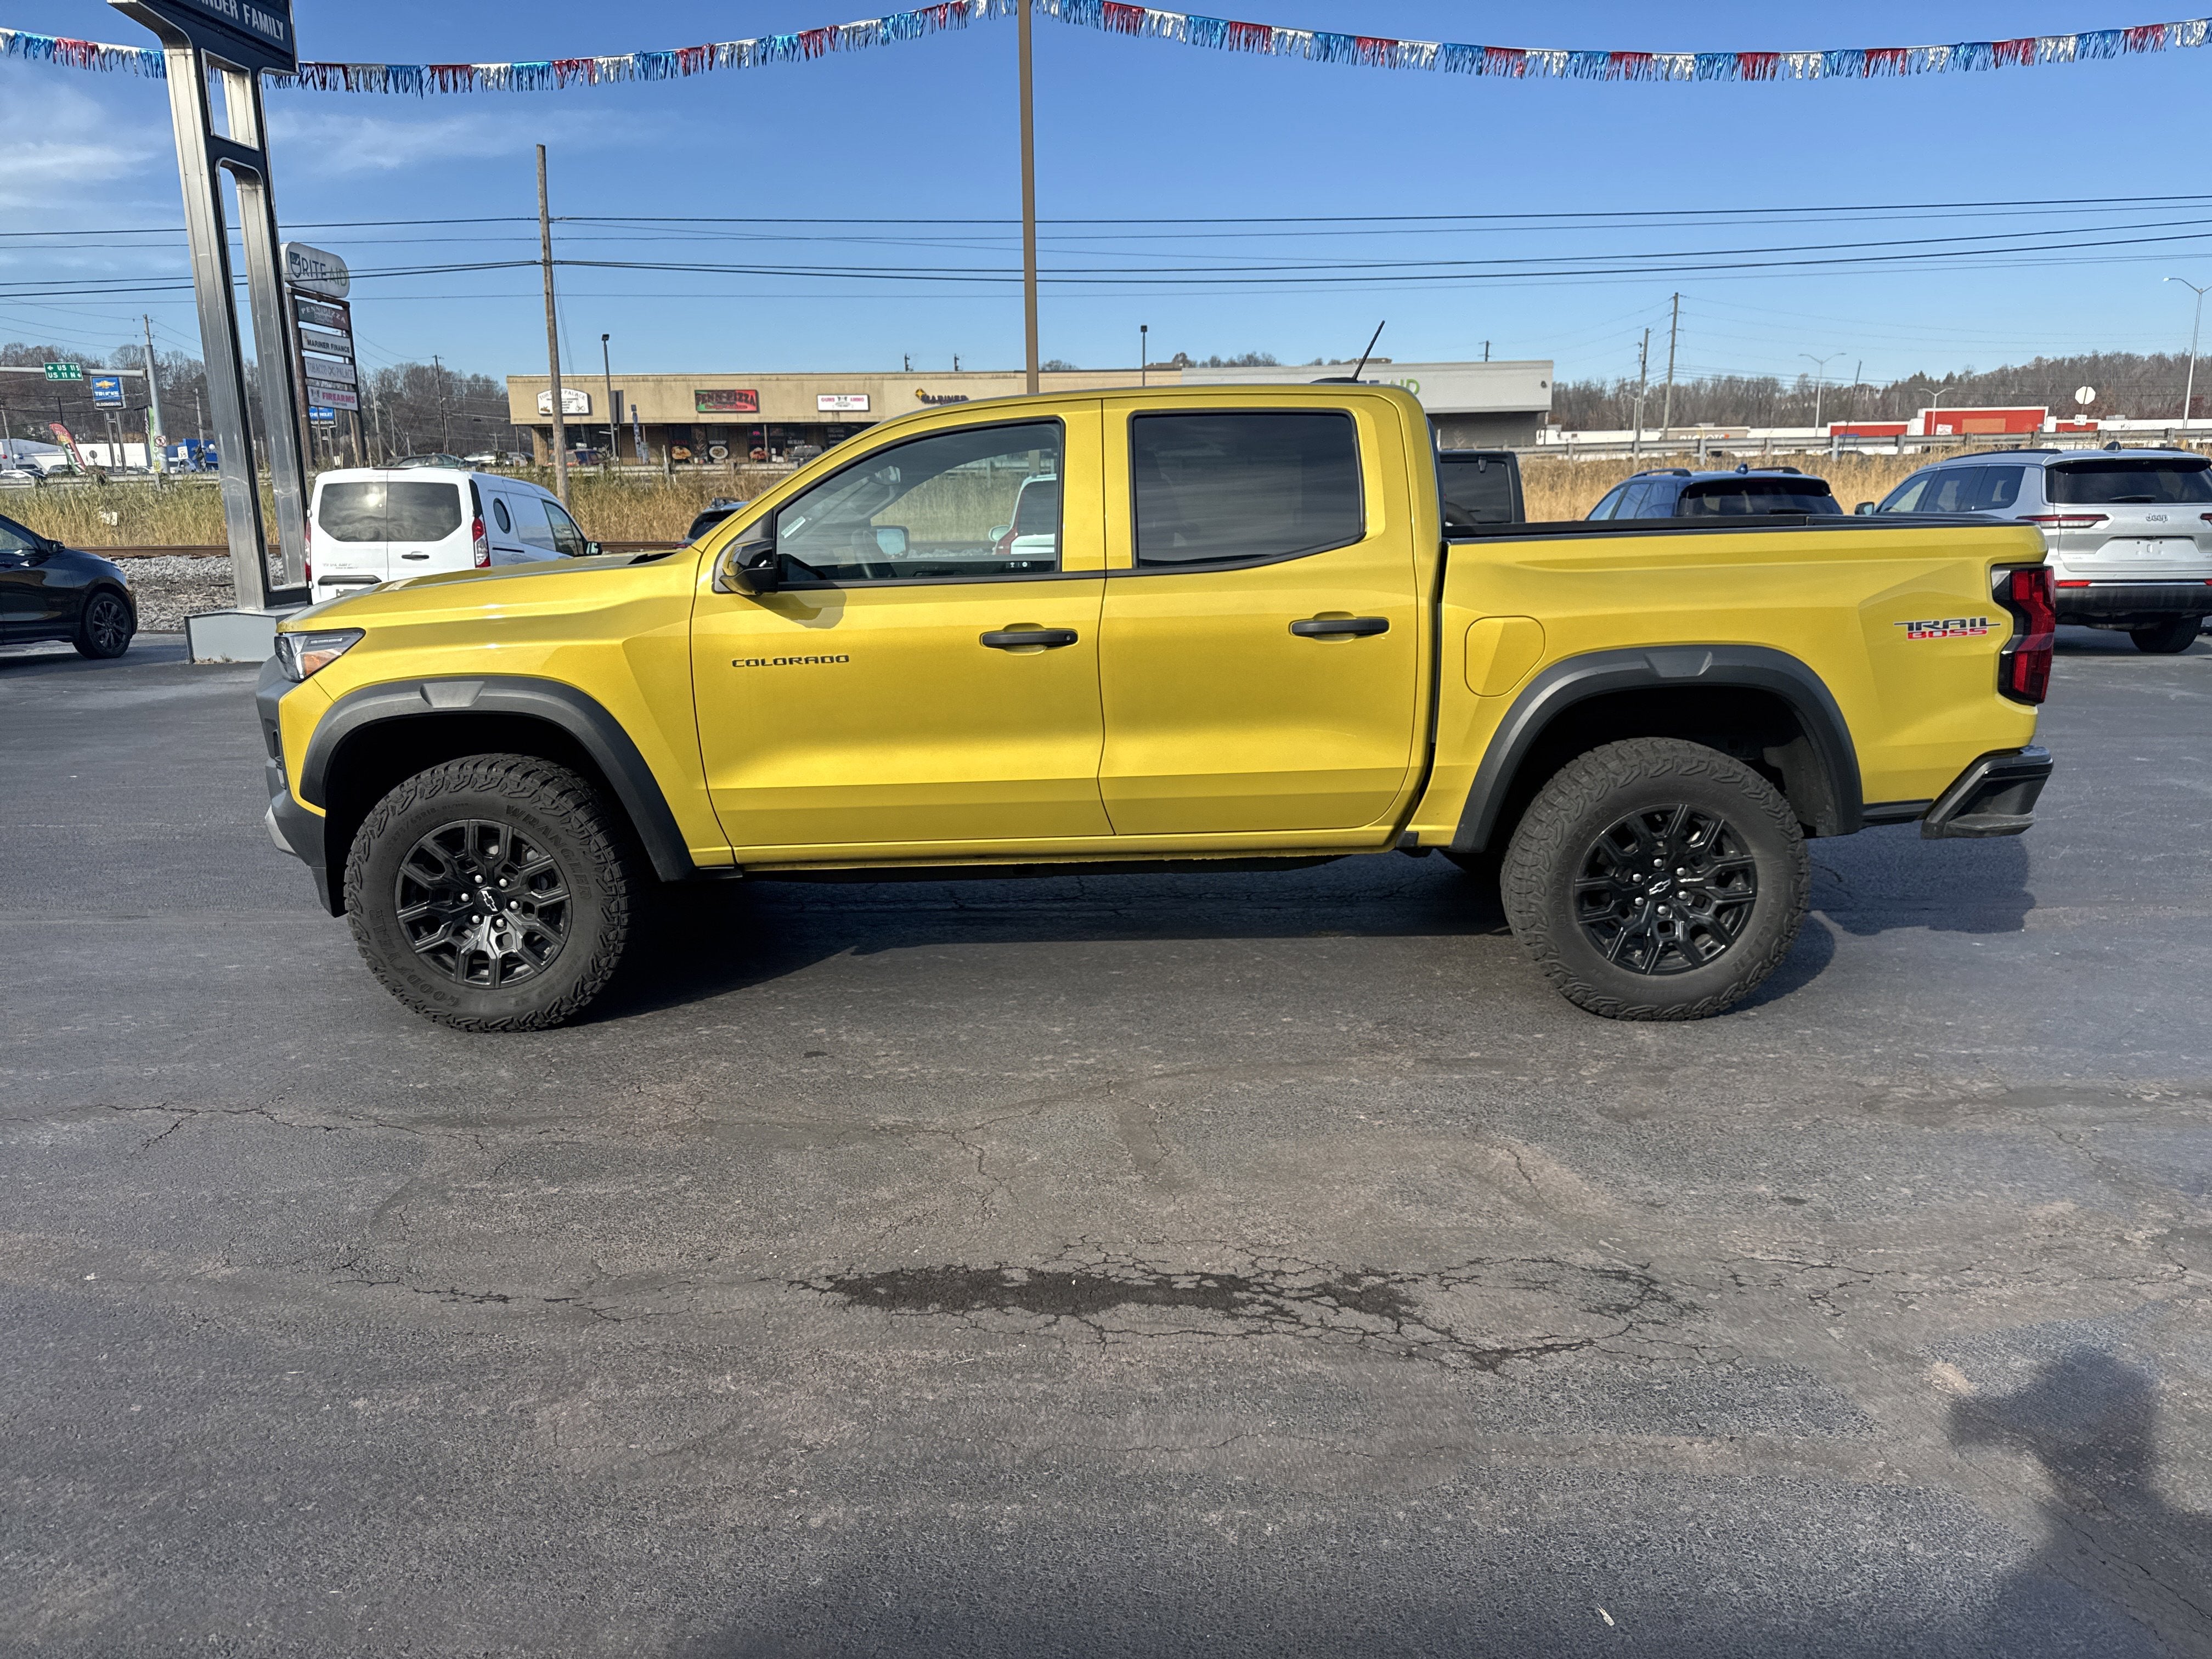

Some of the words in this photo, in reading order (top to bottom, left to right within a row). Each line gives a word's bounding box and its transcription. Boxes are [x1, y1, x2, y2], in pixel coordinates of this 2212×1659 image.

[242, 3, 284, 41] FAMILY
[302, 257, 326, 281] RITE
[329, 266, 347, 286] AID
[307, 338, 330, 349] MARINER
[330, 343, 350, 353] FINANCE
[322, 392, 356, 404] FIREARMS
[2146, 514, 2169, 523] Jeep
[1894, 618, 2001, 631] TRAIL
[1908, 627, 1988, 640] BOSS
[731, 654, 850, 668] COLORADO
[506, 804, 592, 900] WRANGLER
